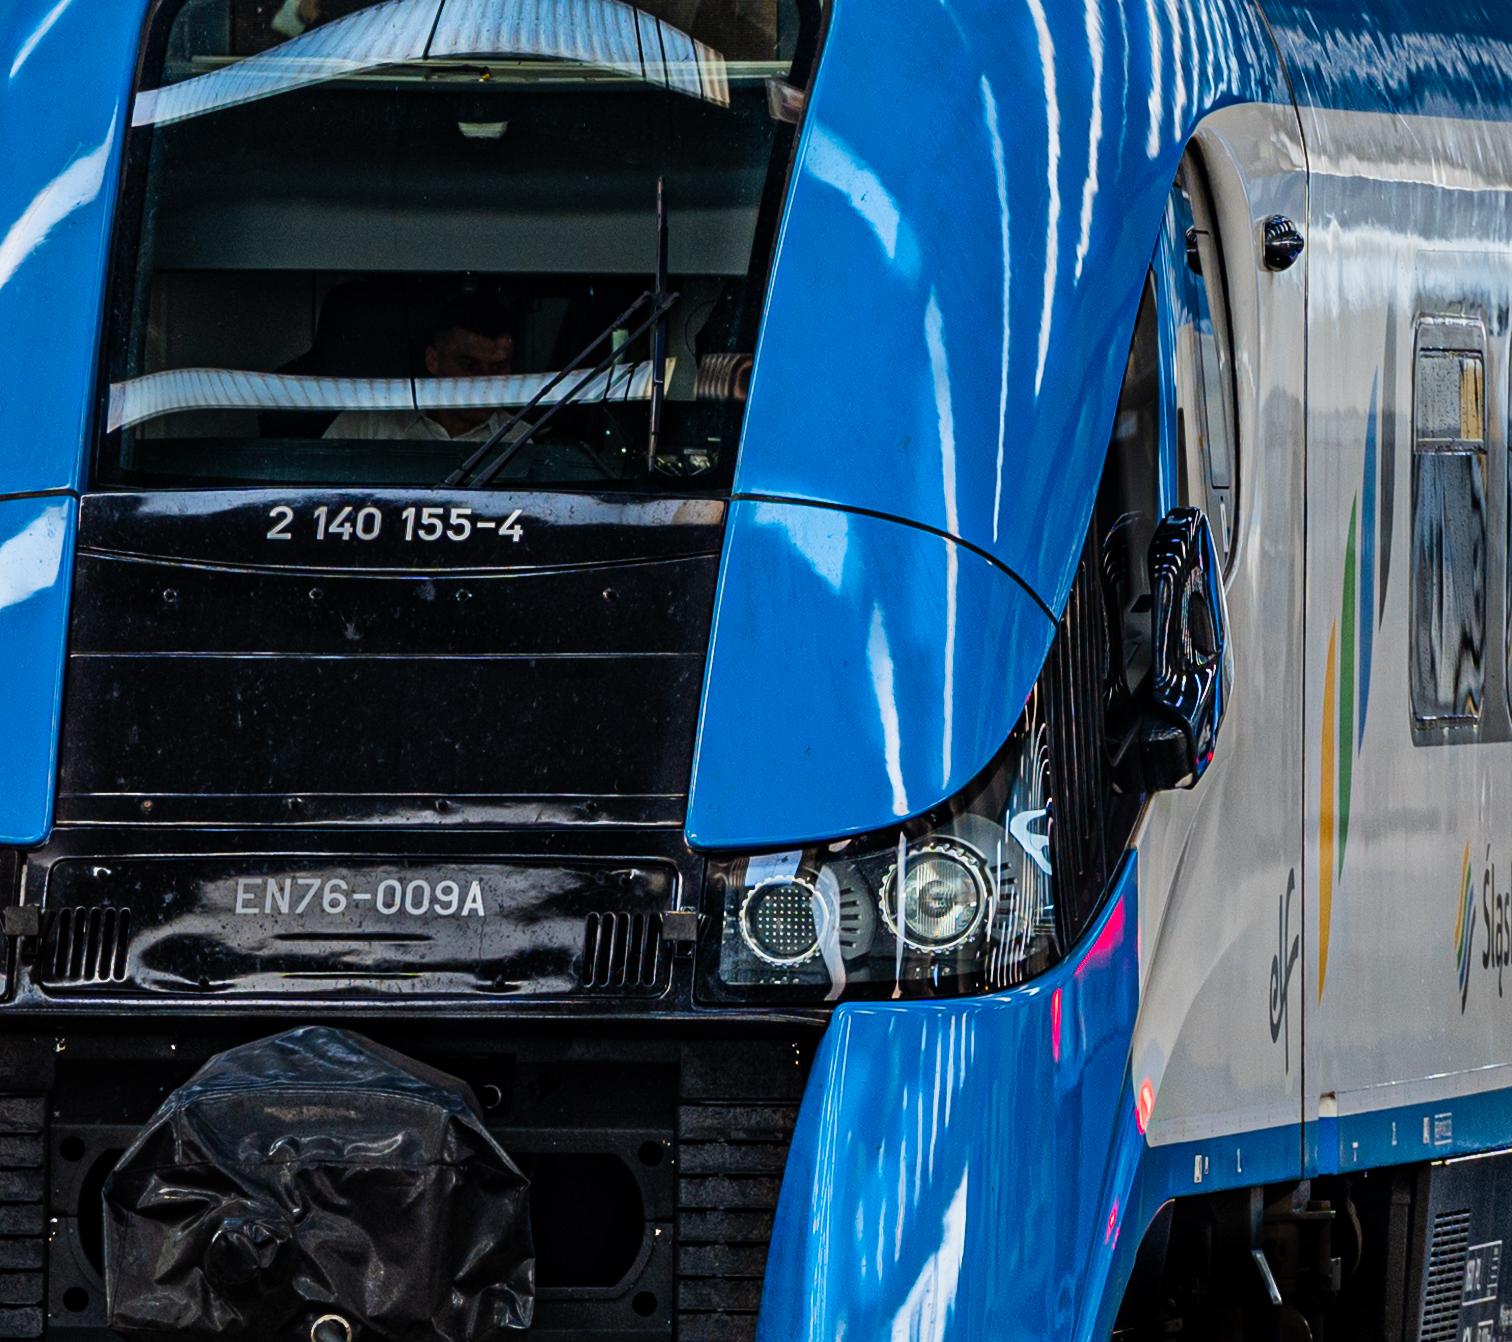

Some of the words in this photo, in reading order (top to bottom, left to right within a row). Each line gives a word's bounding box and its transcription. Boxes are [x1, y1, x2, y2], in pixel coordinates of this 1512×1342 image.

[266, 505, 294, 540] 2
[313, 506, 382, 540] 140
[401, 507, 524, 542] 155-4
[235, 878, 485, 917] EN76-009A
